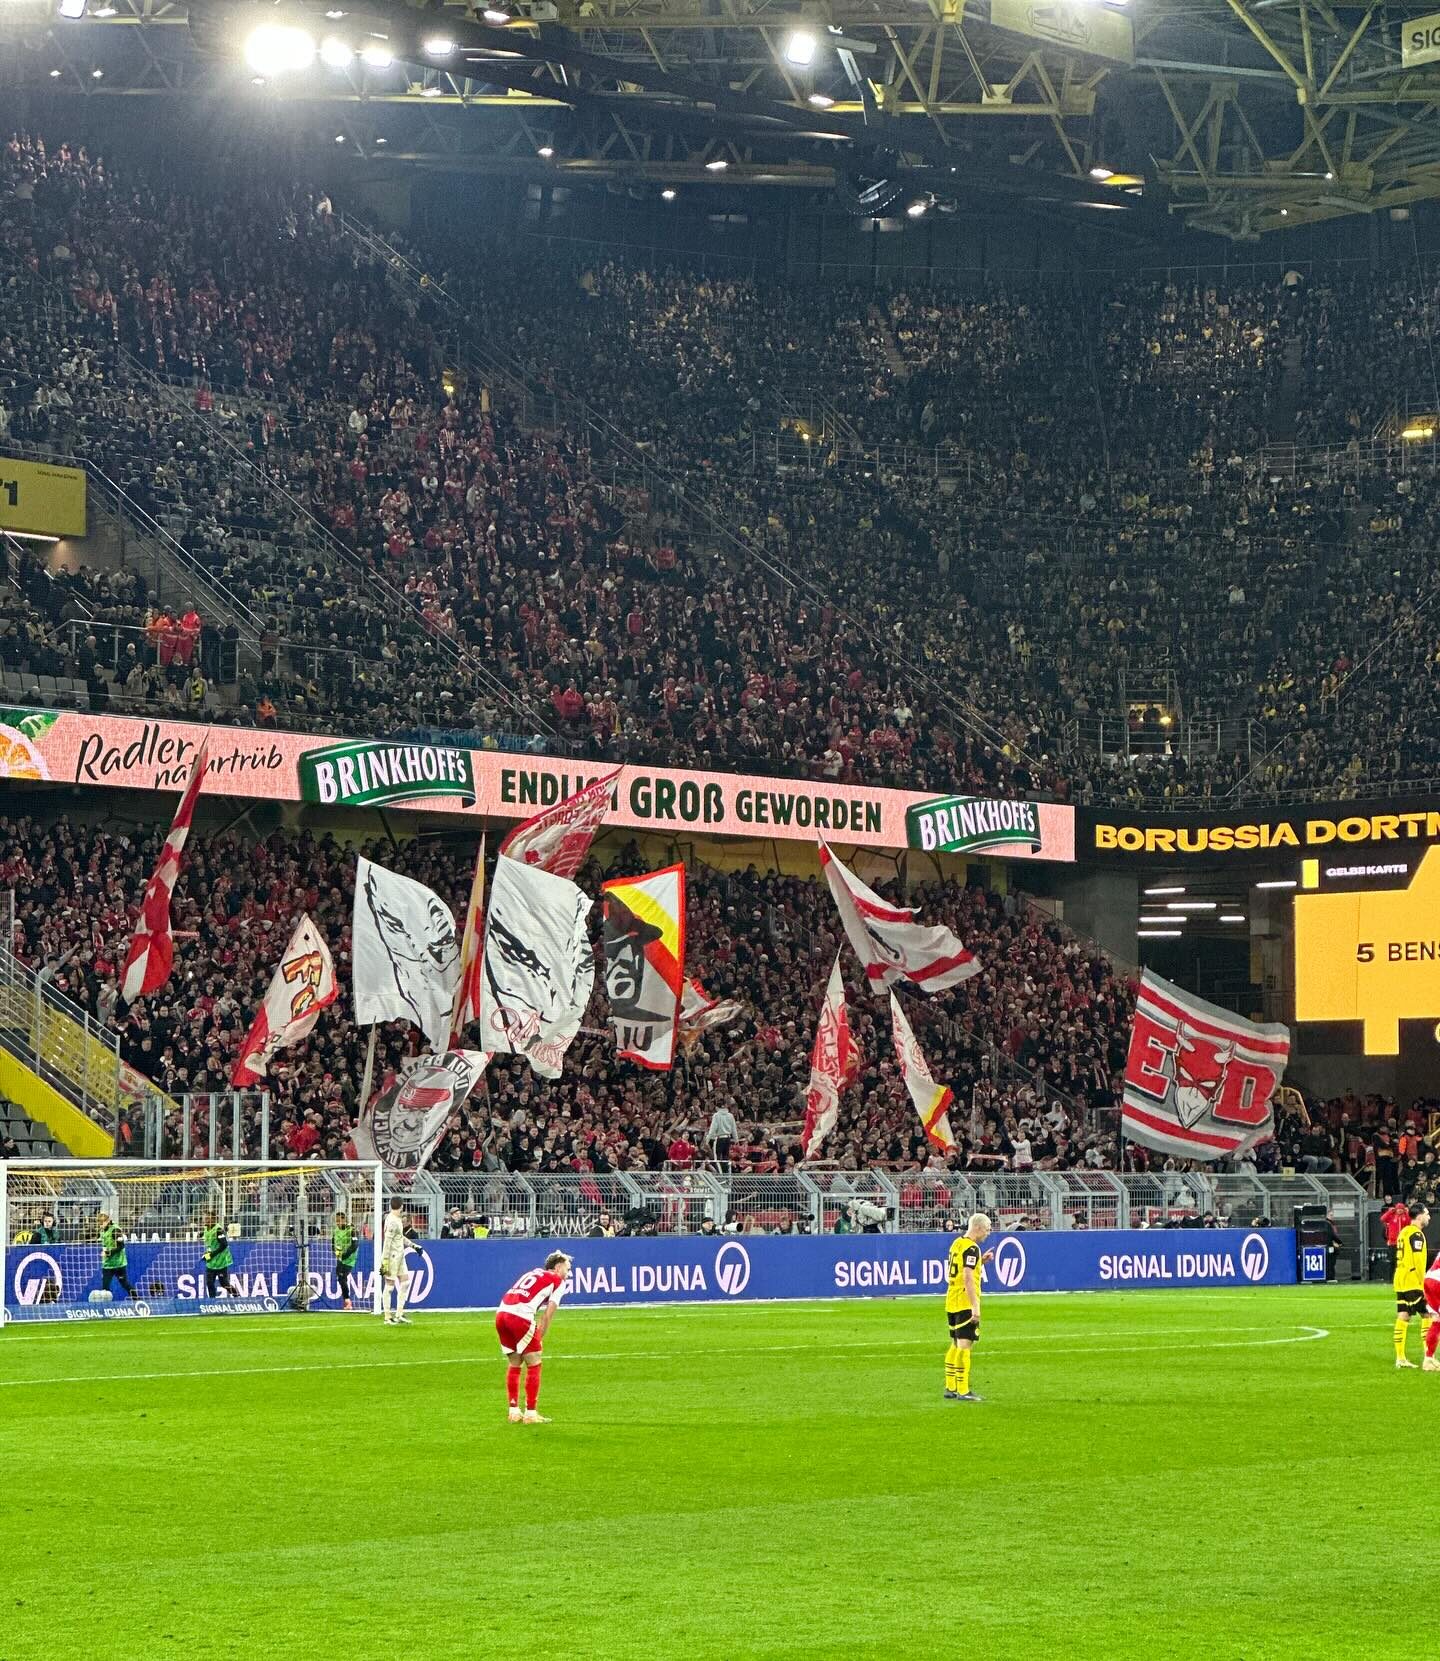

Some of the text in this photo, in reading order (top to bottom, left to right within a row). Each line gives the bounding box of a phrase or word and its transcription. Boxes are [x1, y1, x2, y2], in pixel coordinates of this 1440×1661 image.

[76, 723, 194, 783] Radler
[315, 746, 467, 802] BRINKHOFF's
[736, 789, 882, 832] GEWORDEN
[1095, 823, 1300, 852] BORUSSIA
[1356, 940, 1440, 963] 5 BEN
[834, 1260, 918, 1287] SIGNAL
[1099, 1253, 1236, 1280] SIGNAL IDUNA
[1305, 1254, 1323, 1271] 1&1
[632, 1264, 707, 1292] IDUNA
[66, 1307, 135, 1319] SIGNAL IDUNA
[200, 1303, 264, 1313] SIGNAL IDUNA
